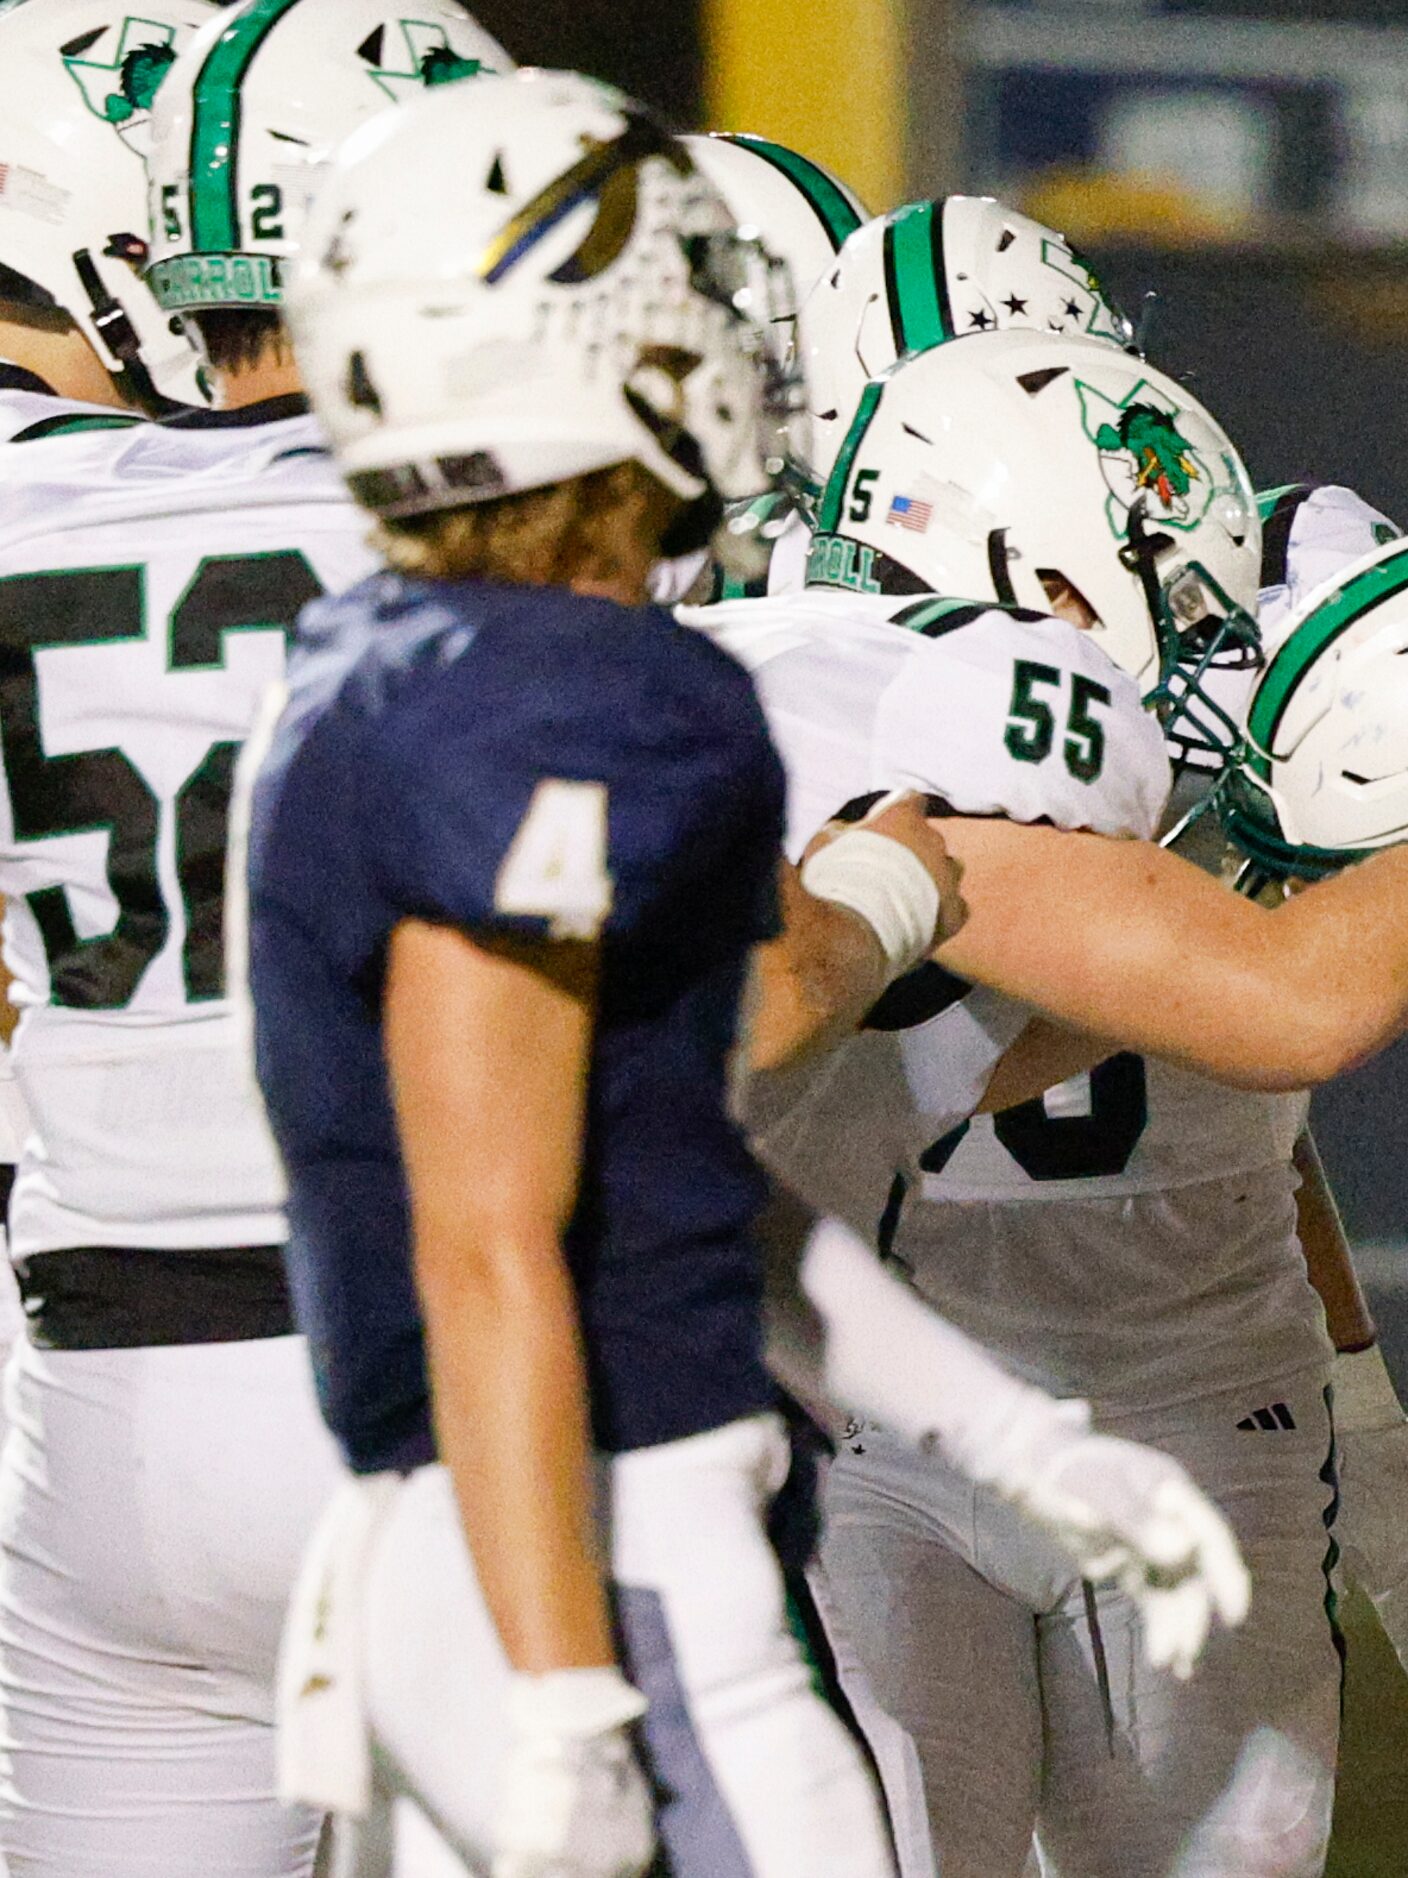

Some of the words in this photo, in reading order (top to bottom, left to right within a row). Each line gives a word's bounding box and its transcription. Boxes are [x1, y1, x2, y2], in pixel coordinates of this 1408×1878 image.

[251, 184, 284, 240] 2
[849, 468, 880, 522] 5
[1002, 658, 1112, 787] 55
[494, 778, 614, 942] 4
